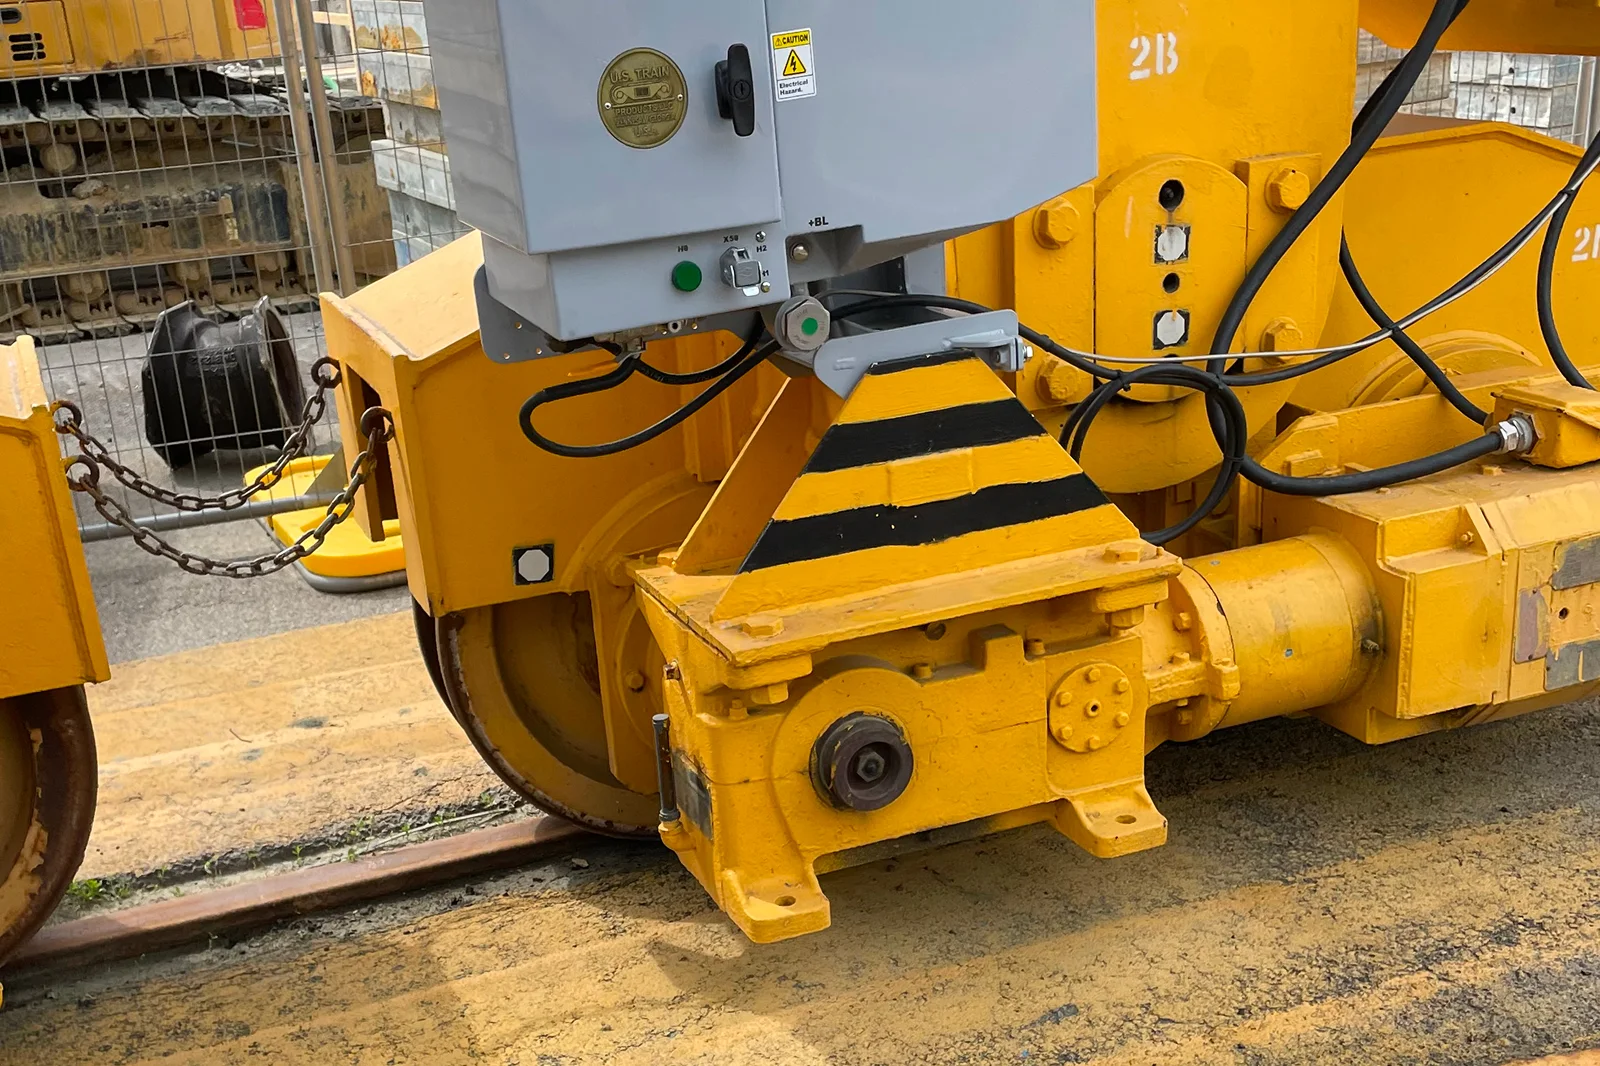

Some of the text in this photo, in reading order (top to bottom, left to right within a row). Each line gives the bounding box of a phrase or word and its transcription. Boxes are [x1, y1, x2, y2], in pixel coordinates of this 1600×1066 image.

[782, 34, 809, 45] CAUTION
[1129, 32, 1179, 81] 2B
[609, 65, 671, 85] U.S. TRAIN
[779, 79, 809, 89] Electrical
[779, 87, 803, 96] Hazard.
[808, 216, 829, 227] +BL
[756, 244, 767, 253] H2
